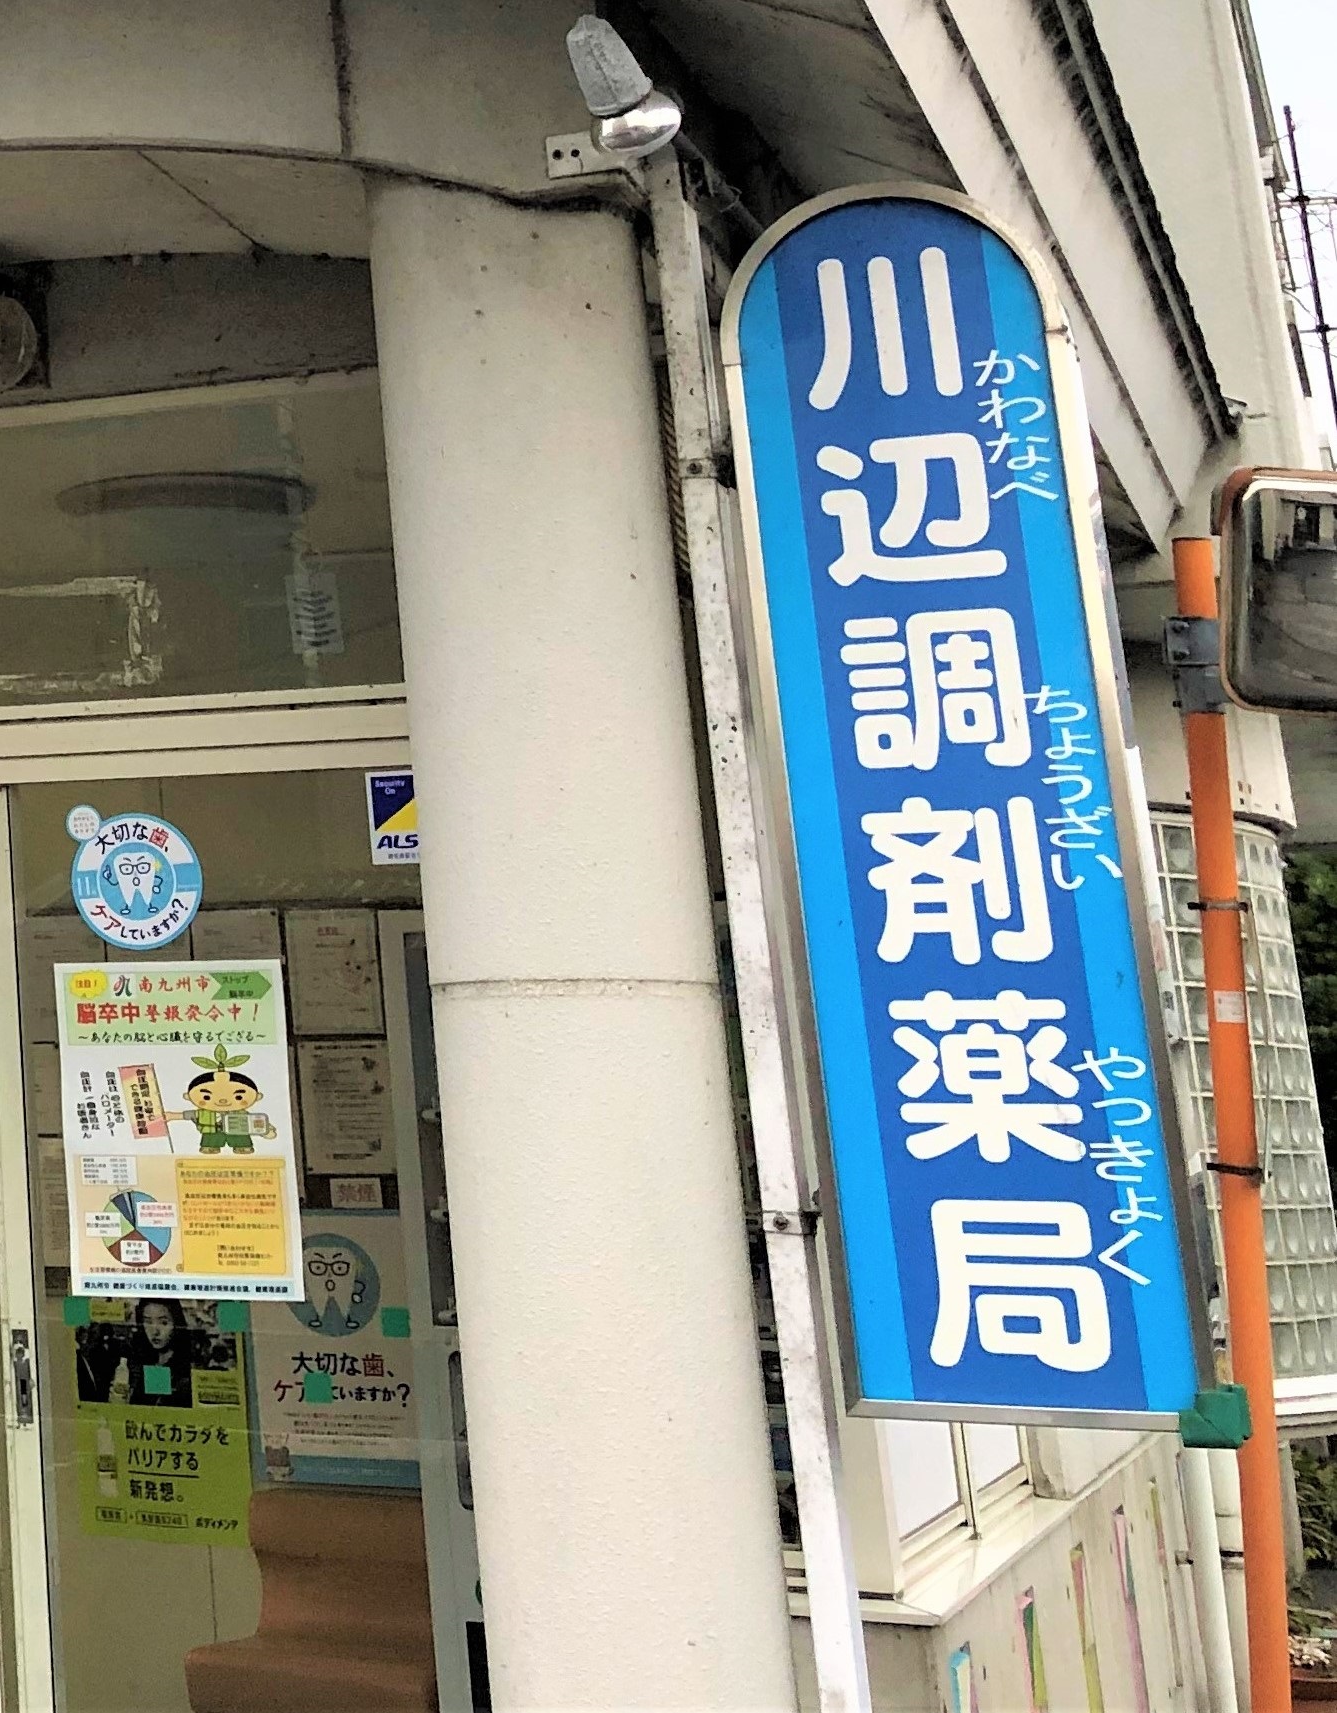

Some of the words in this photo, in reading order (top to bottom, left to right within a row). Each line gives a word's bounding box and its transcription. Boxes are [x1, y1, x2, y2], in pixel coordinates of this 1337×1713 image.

[974, 350, 1059, 501] かわなべ
[1024, 686, 1123, 889] ちょうざい
[809, 247, 1111, 1372] 川辺調剤薬局
[125, 1420, 229, 1446] 飲んでカラダを
[128, 1449, 199, 1471] バリアする
[129, 1479, 184, 1503] 新発想。
